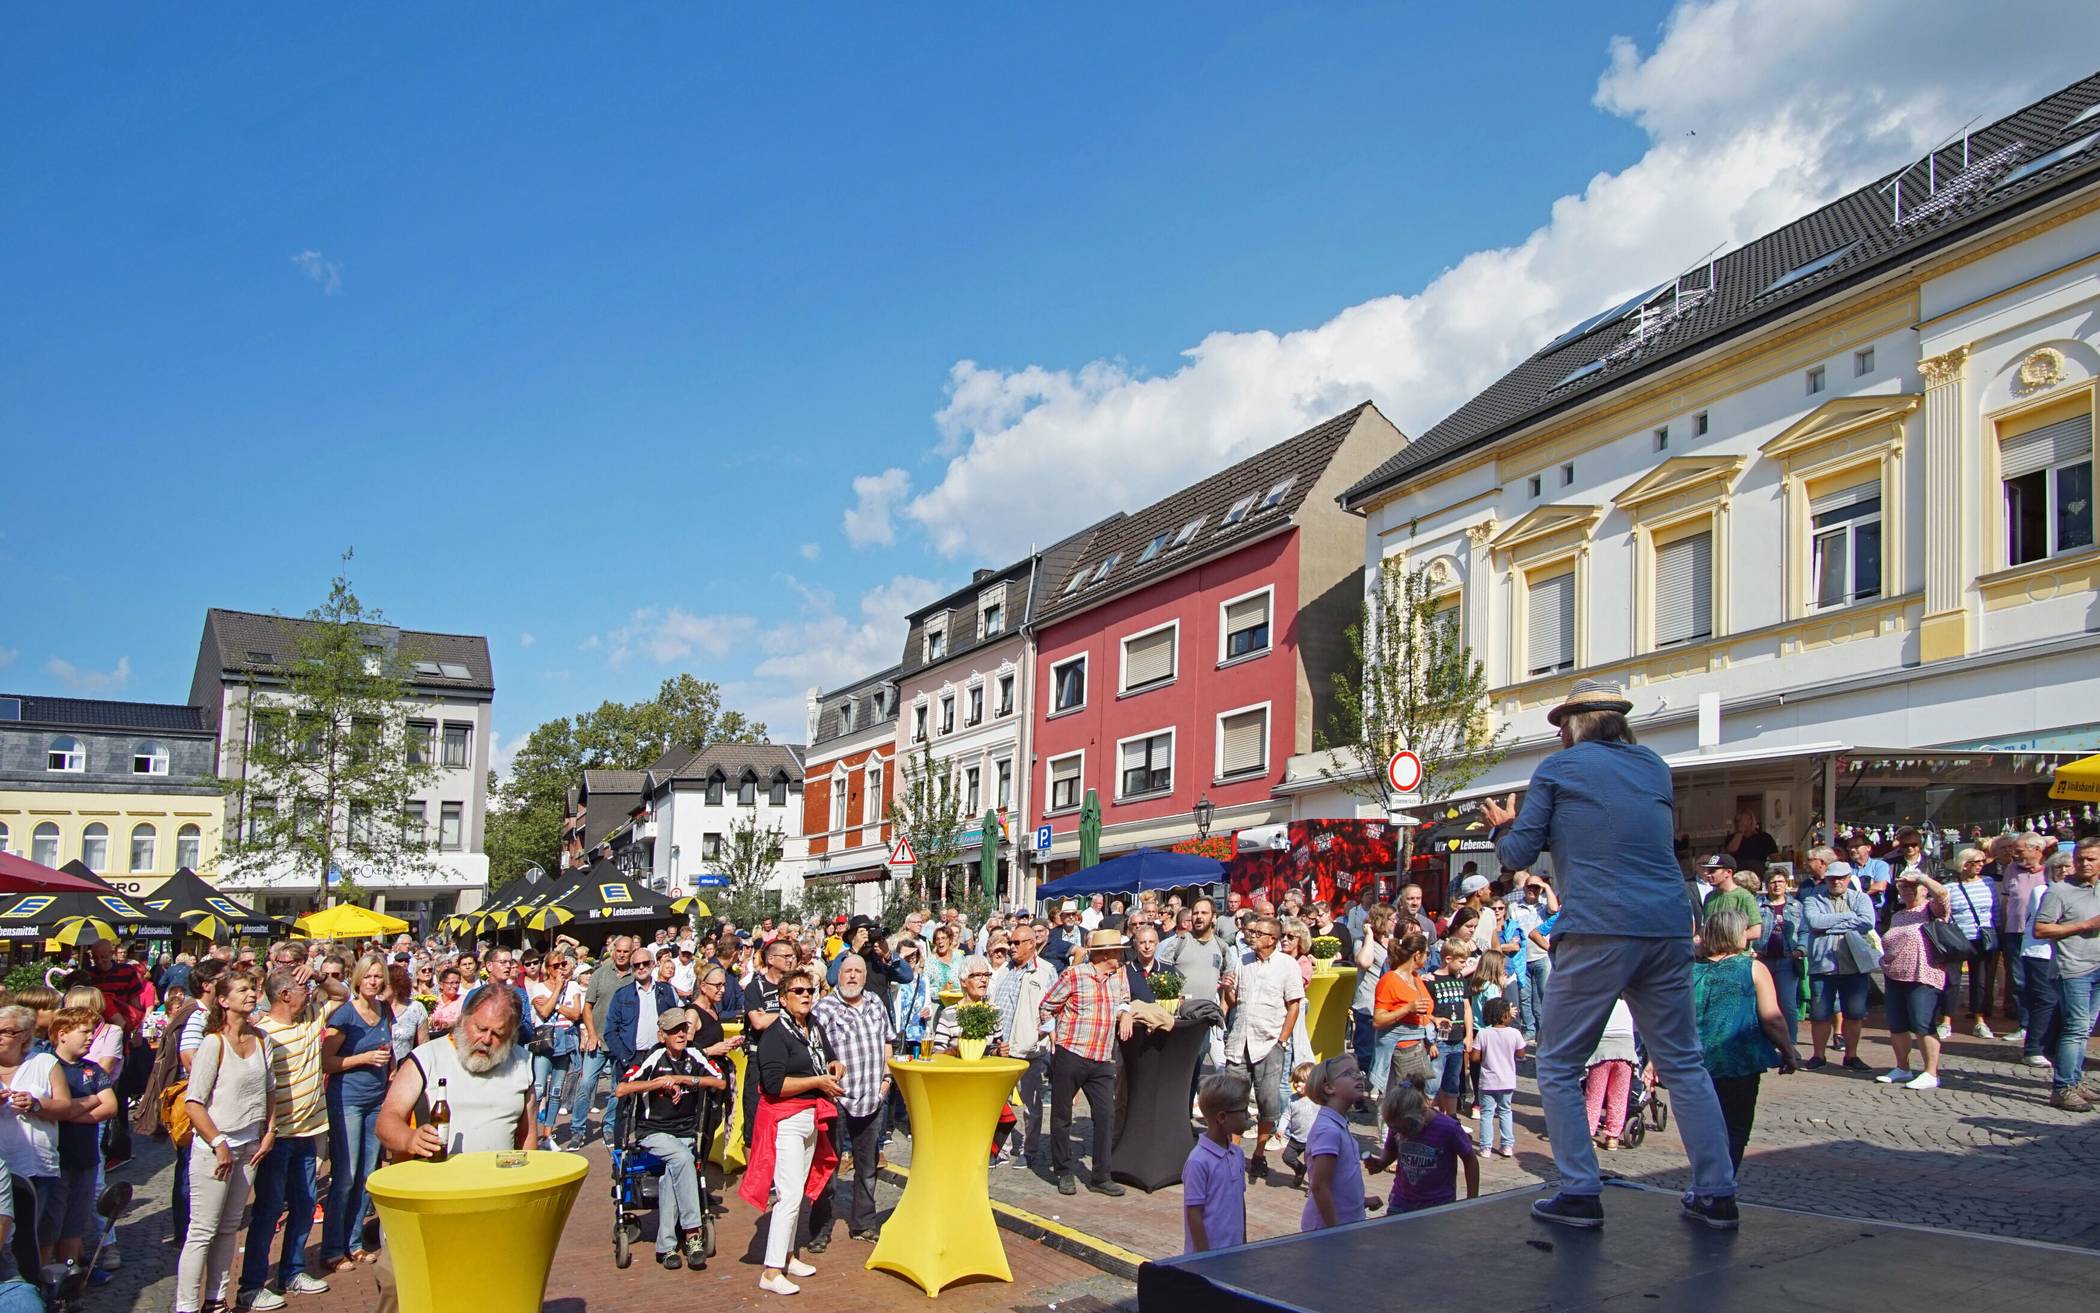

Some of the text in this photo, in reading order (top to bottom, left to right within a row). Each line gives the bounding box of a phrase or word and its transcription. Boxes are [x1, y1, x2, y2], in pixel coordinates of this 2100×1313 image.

[1040, 828, 1049, 847] P
[1434, 841, 1448, 852] Wir
[589, 905, 655, 918] Wir Lebensmittel.
